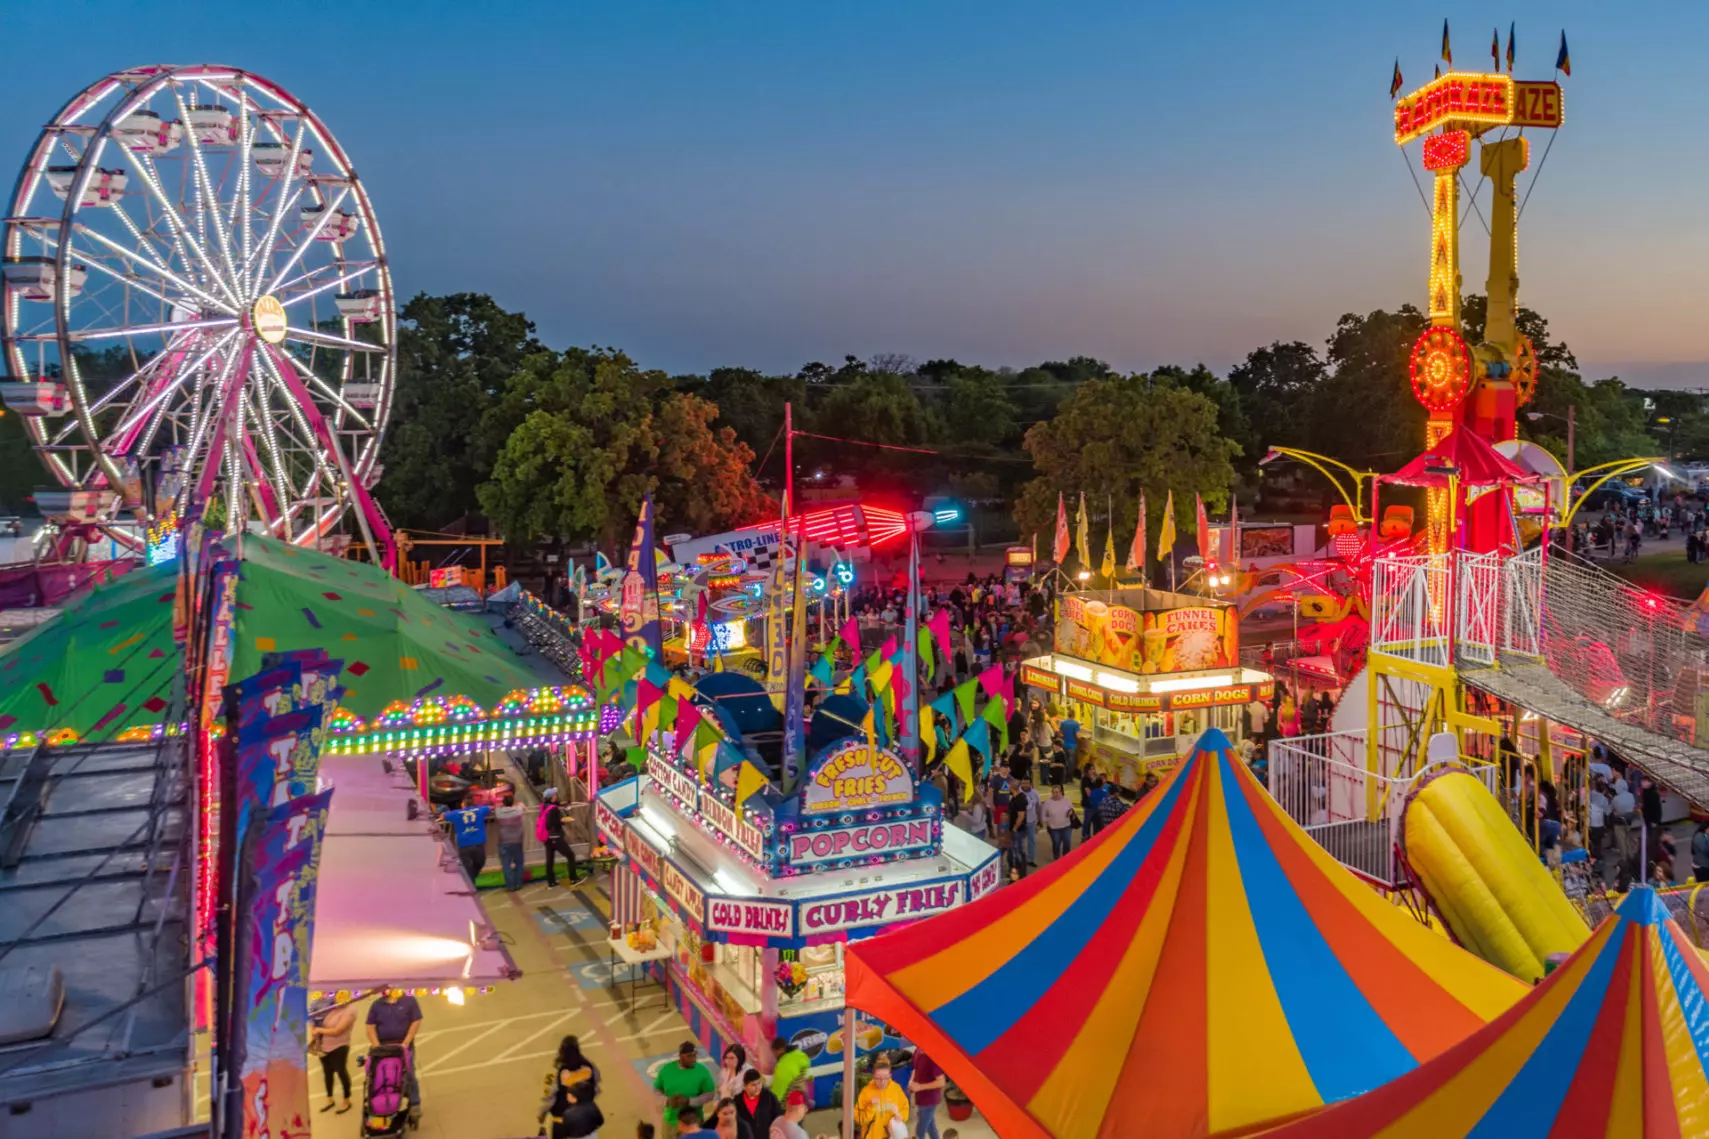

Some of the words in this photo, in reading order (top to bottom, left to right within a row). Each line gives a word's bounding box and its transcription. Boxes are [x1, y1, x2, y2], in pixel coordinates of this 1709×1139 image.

[1111, 608, 1137, 623] CORN
[1111, 619, 1137, 633] DOGS
[1166, 608, 1217, 625] FUNNEL
[1166, 619, 1217, 635] CAKES
[1172, 692, 1211, 706] CORN
[1214, 688, 1249, 701] DOGS
[815, 748, 868, 788] FRESH
[833, 774, 888, 798] FRIES
[791, 821, 930, 860] POPCORN
[805, 892, 892, 929] CURLY
[895, 880, 960, 914] FRIES
[712, 902, 741, 928] COLD
[745, 903, 790, 933] DRINKS
